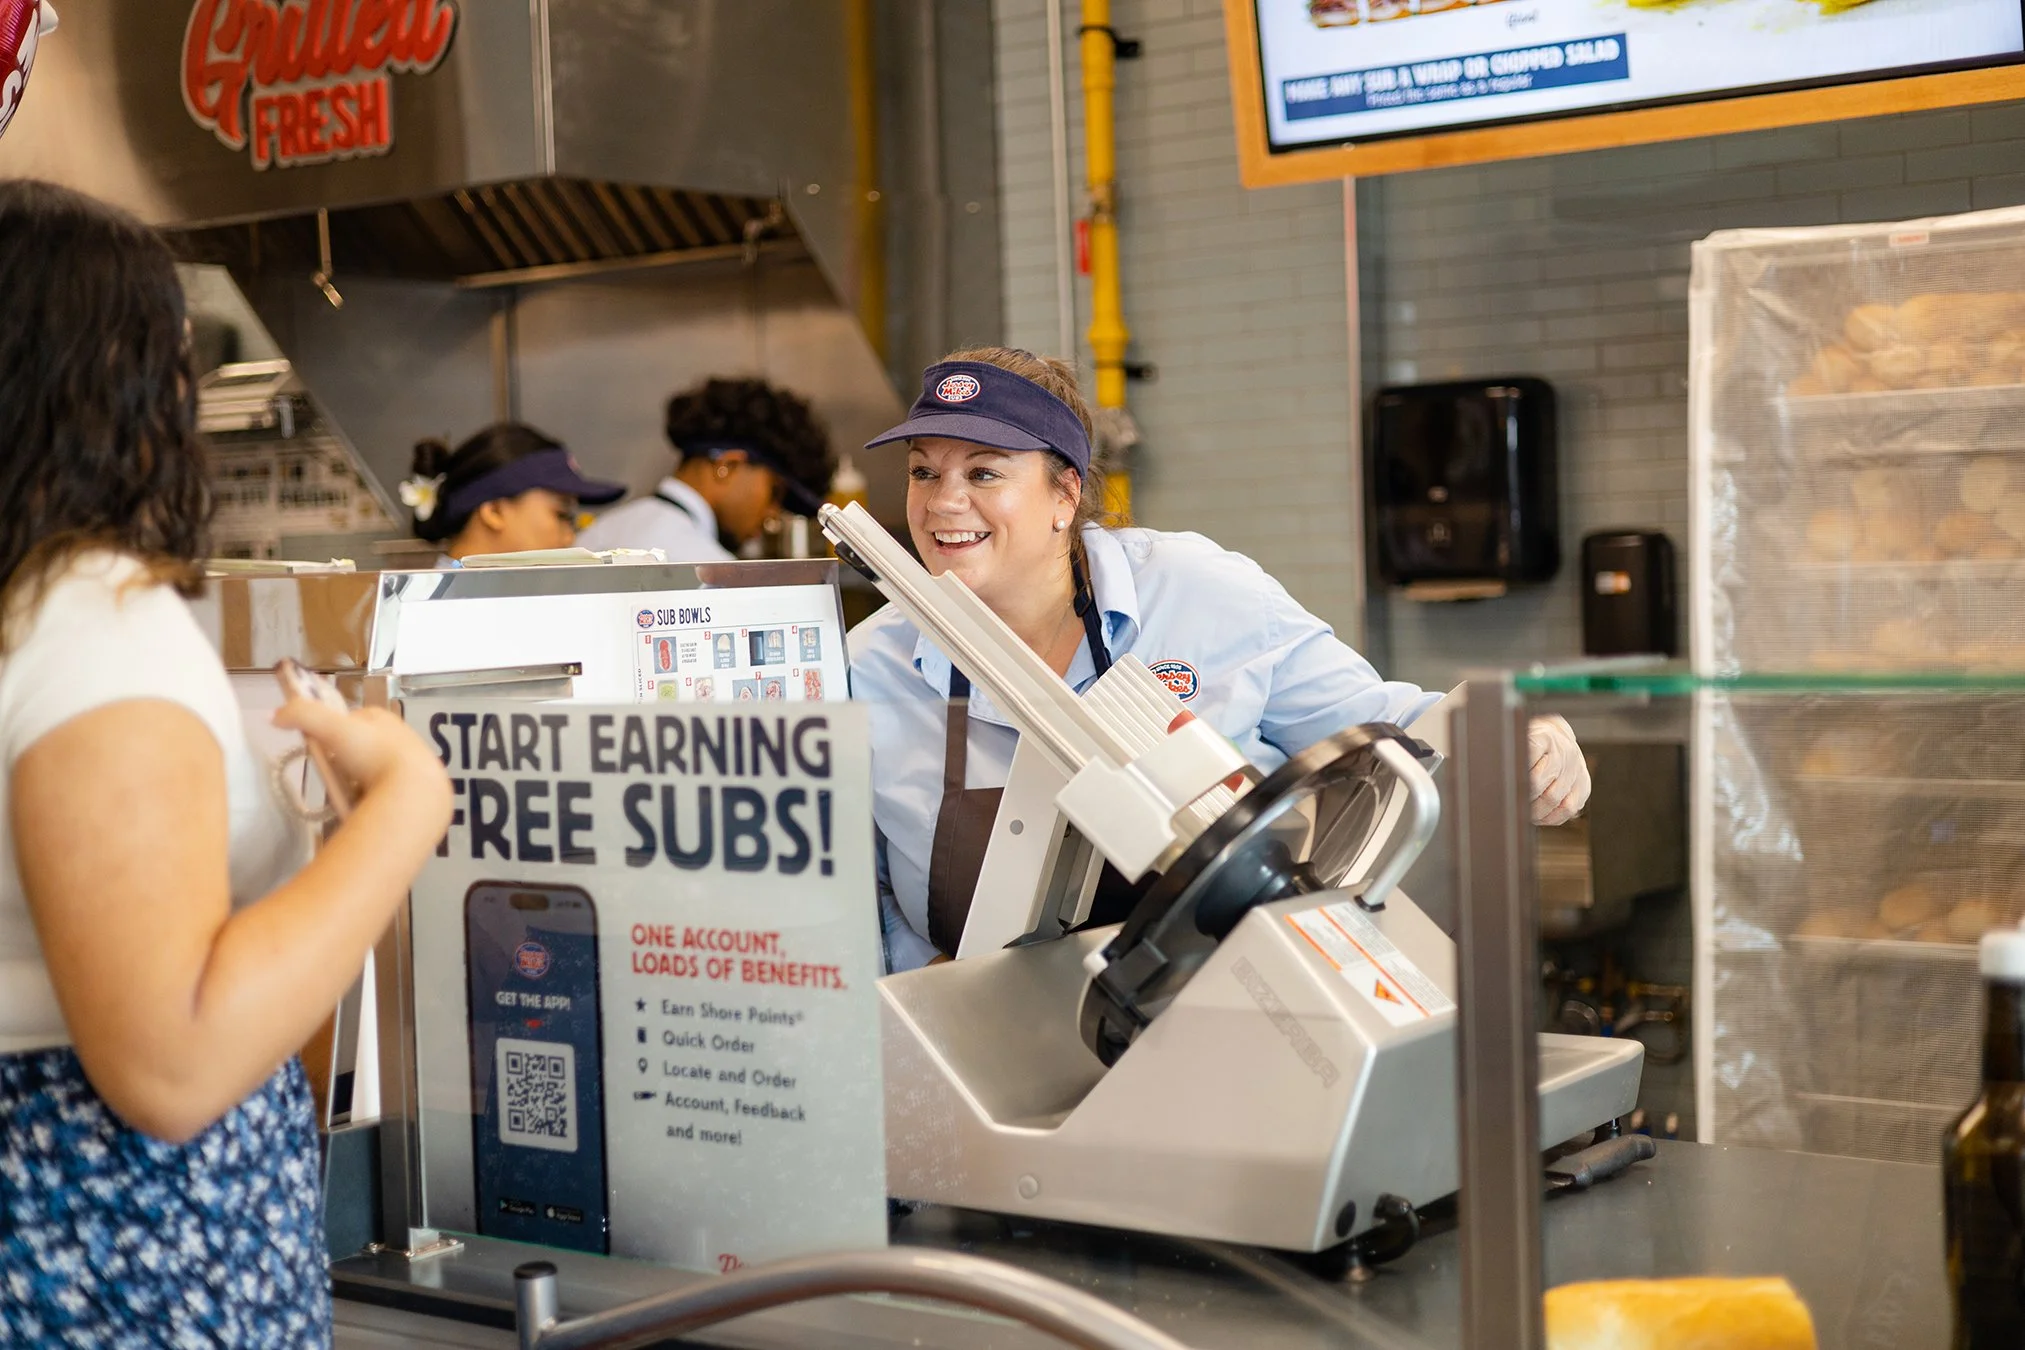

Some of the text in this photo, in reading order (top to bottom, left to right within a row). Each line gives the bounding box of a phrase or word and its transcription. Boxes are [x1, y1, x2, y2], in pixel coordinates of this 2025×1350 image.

[1330, 73, 1363, 98] ANY
[1363, 68, 1397, 93] SUB
[1397, 66, 1413, 89] A
[1411, 59, 1464, 86] WRAP
[1463, 55, 1490, 80] OR
[1490, 45, 1565, 76] CHOPPED
[1565, 38, 1621, 67] SALAD
[255, 77, 391, 161] FRESH
[657, 609, 676, 626] SUB
[678, 606, 711, 624] BOWLS
[1155, 672, 1190, 684] ersey
[430, 712, 832, 779] START EARNING
[436, 778, 834, 877] FREE SUBS!
[631, 923, 786, 959] ONE ACCOUNT,
[632, 951, 848, 990] LOADS OF BENEFITS.
[496, 991, 571, 1012] GET THE APP!
[662, 999, 694, 1017] Earn
[701, 1002, 742, 1021] Shore
[663, 1029, 755, 1053] Quick Order
[664, 1060, 797, 1089] Locate and Order
[665, 1091, 806, 1121] Account, Feedback
[667, 1123, 742, 1146] and more!
